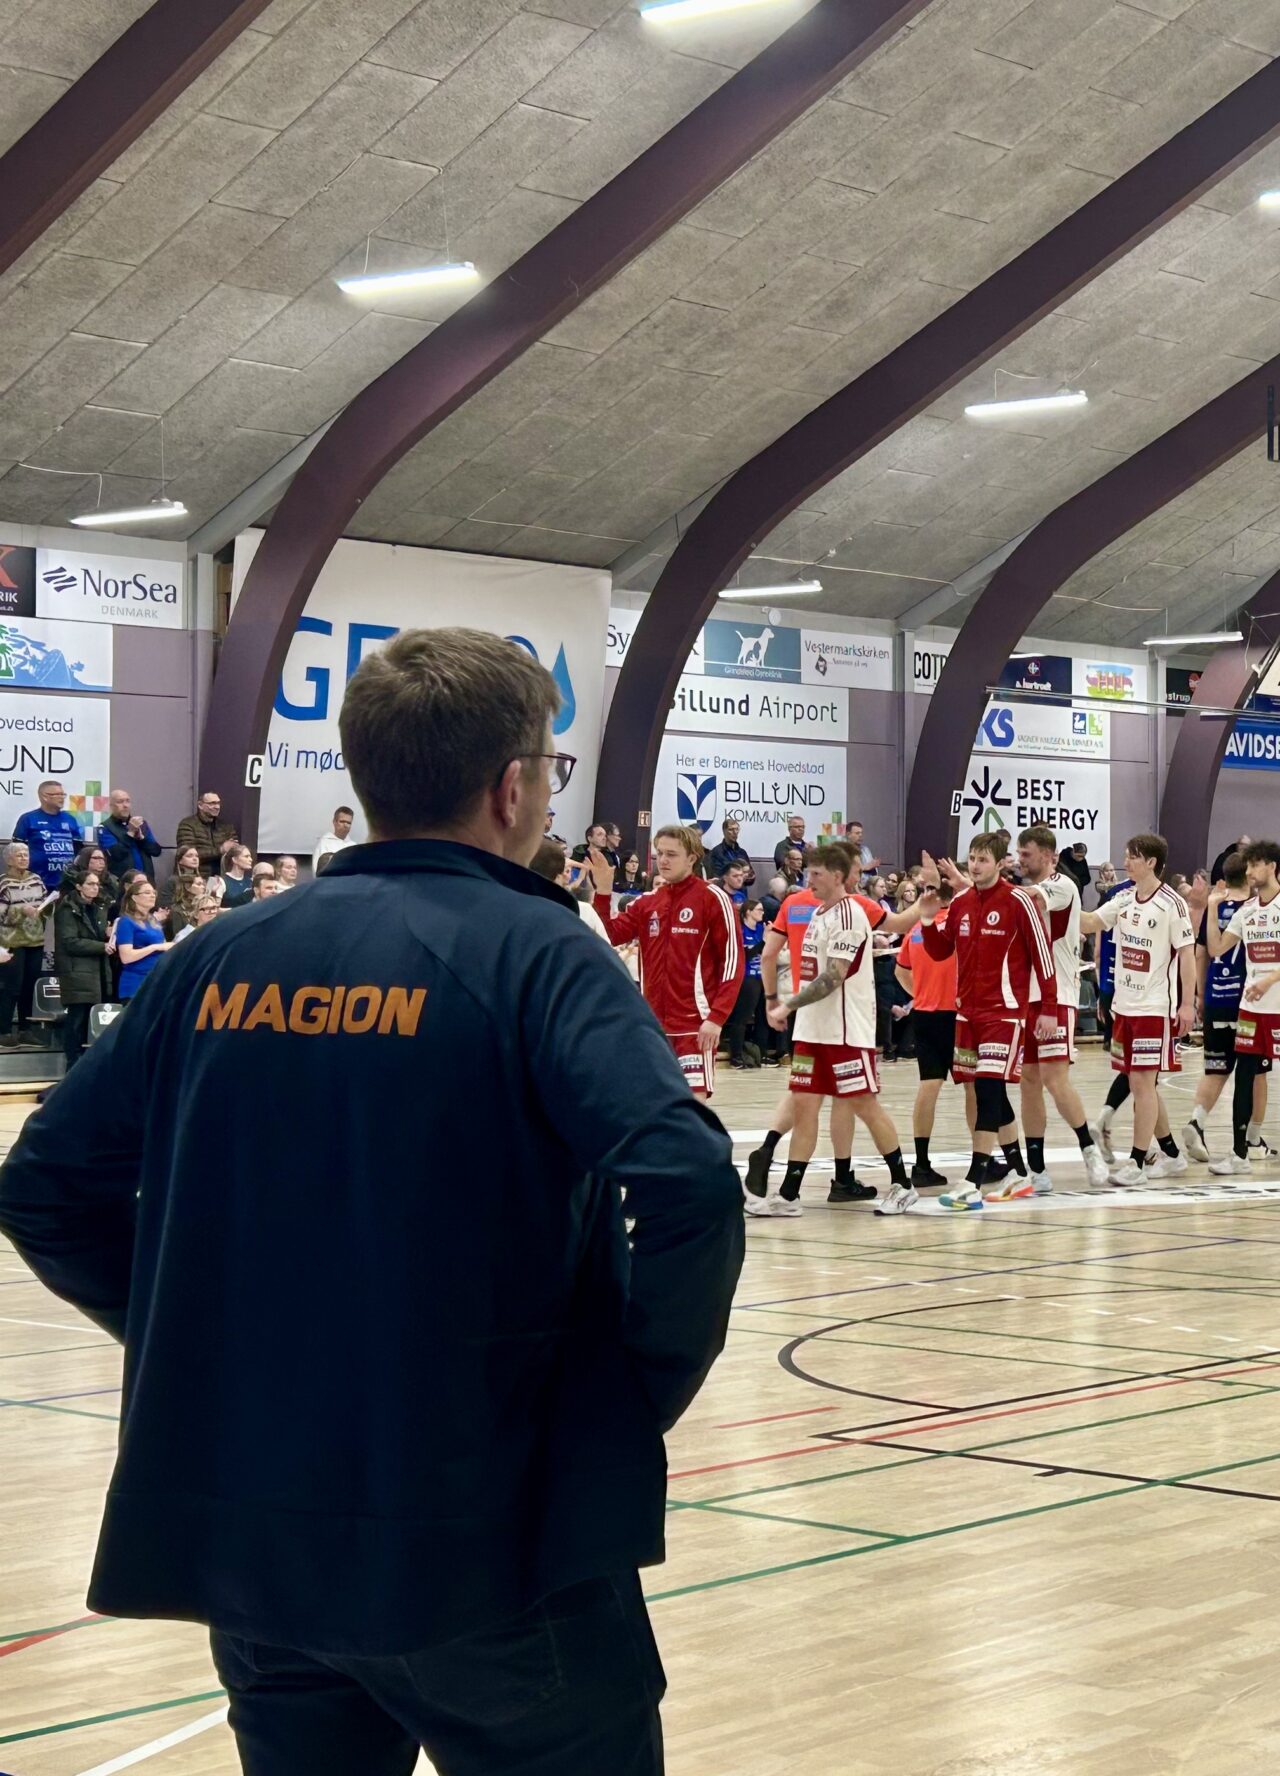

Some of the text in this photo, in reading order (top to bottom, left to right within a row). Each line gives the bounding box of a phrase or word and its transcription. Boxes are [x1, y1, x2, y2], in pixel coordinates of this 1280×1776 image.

[81, 568, 177, 604] NorSea
[101, 605, 158, 619] DENMARK
[670, 688, 838, 724] illund Airport
[267, 741, 289, 767] Vi
[676, 754, 696, 767] Her
[699, 758, 710, 768] er
[768, 759, 825, 774] Hovedstad
[249, 757, 262, 784] C
[724, 780, 825, 806] BILLUND
[1017, 778, 1065, 801] BEST
[953, 793, 961, 813] B
[724, 809, 793, 823] KOMMUNE
[1017, 806, 1098, 830] ENERGY
[194, 983, 428, 1037] MAGION
